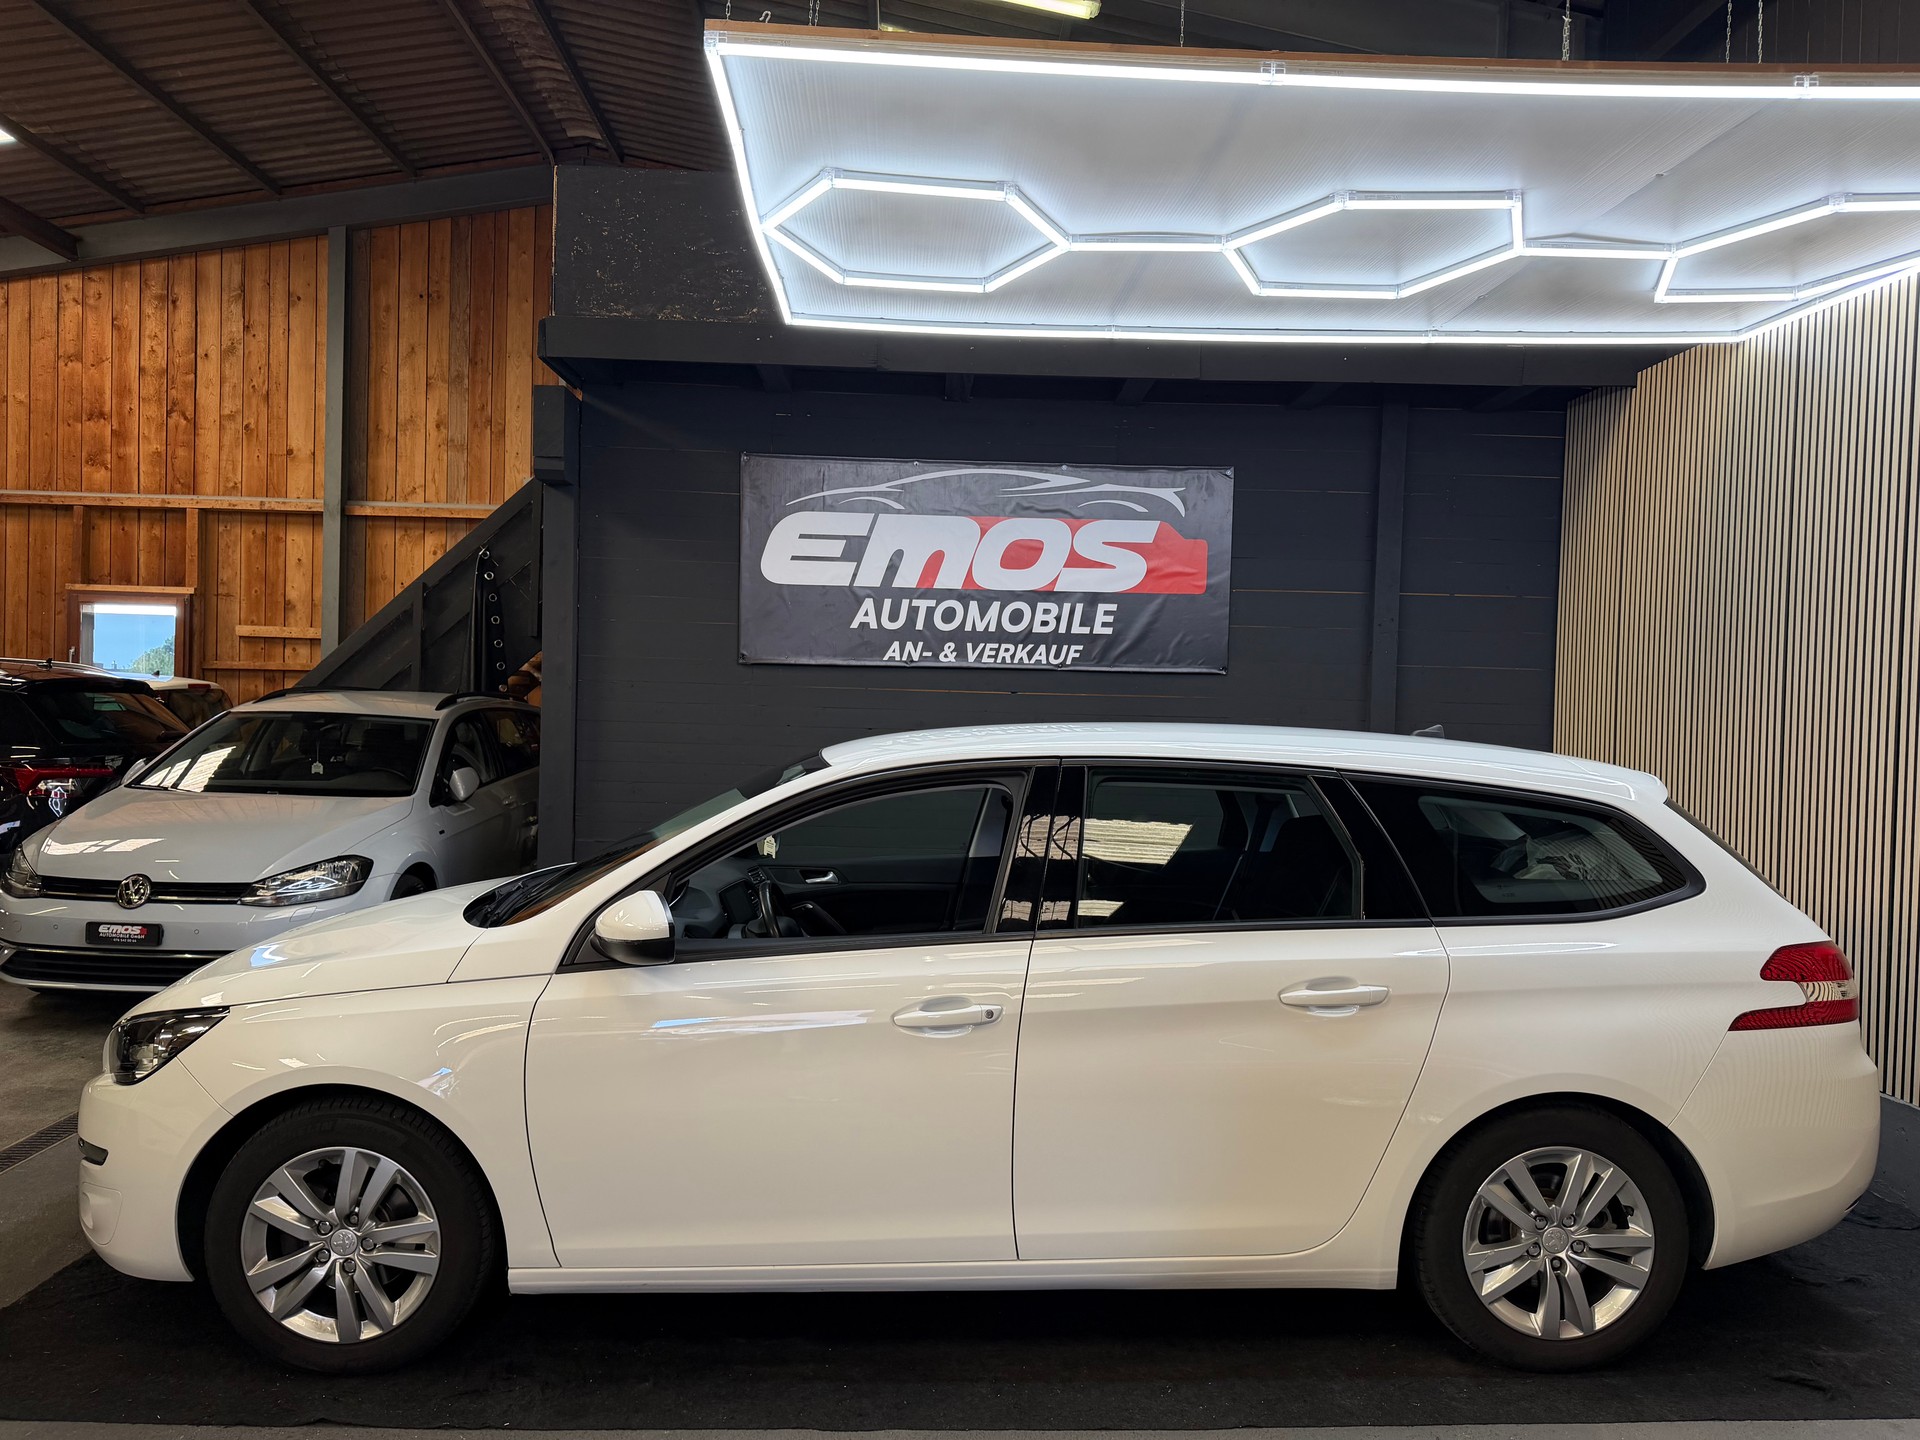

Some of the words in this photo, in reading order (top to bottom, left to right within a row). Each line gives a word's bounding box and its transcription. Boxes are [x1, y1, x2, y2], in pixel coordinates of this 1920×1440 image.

[761, 511, 1160, 592] EMOS
[850, 598, 1118, 635] AUTOMOBILE
[883, 641, 932, 662] AN-
[938, 642, 957, 662] &
[966, 643, 1083, 665] VERKAUF
[98, 924, 143, 934] EMOS
